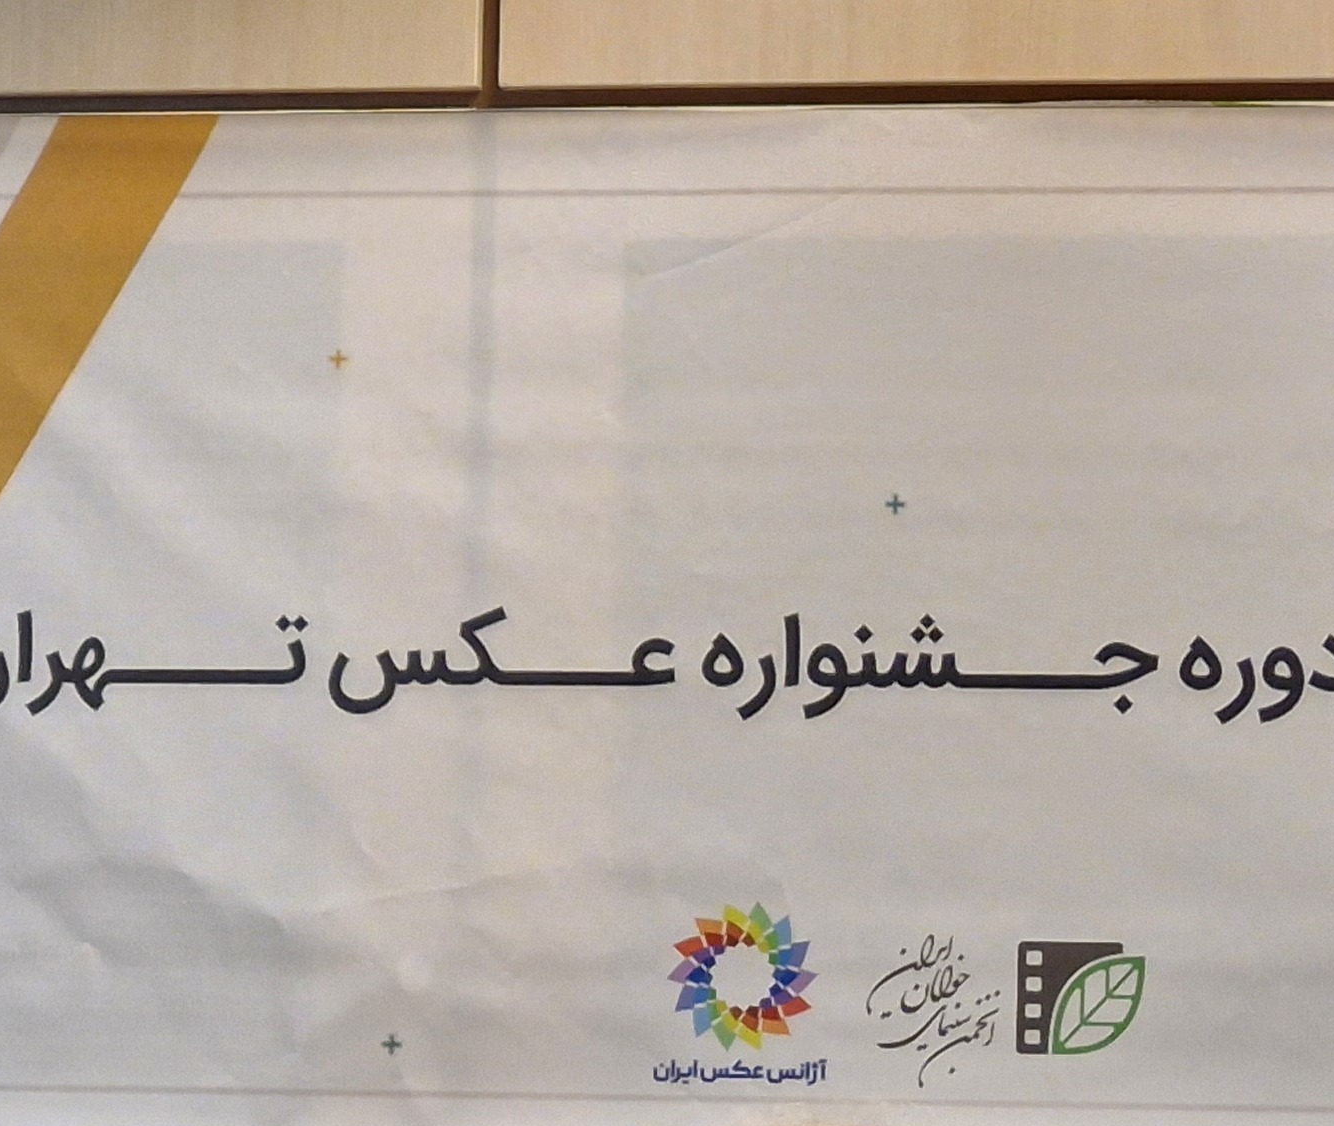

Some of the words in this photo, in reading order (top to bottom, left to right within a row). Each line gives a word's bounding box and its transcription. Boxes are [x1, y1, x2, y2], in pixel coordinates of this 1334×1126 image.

[327, 606, 677, 716] عکس
[700, 612, 1160, 721] جشنواره
[652, 1058, 699, 1085] ایران
[699, 1059, 764, 1084] عکس
[766, 1058, 828, 1087] آژانس
